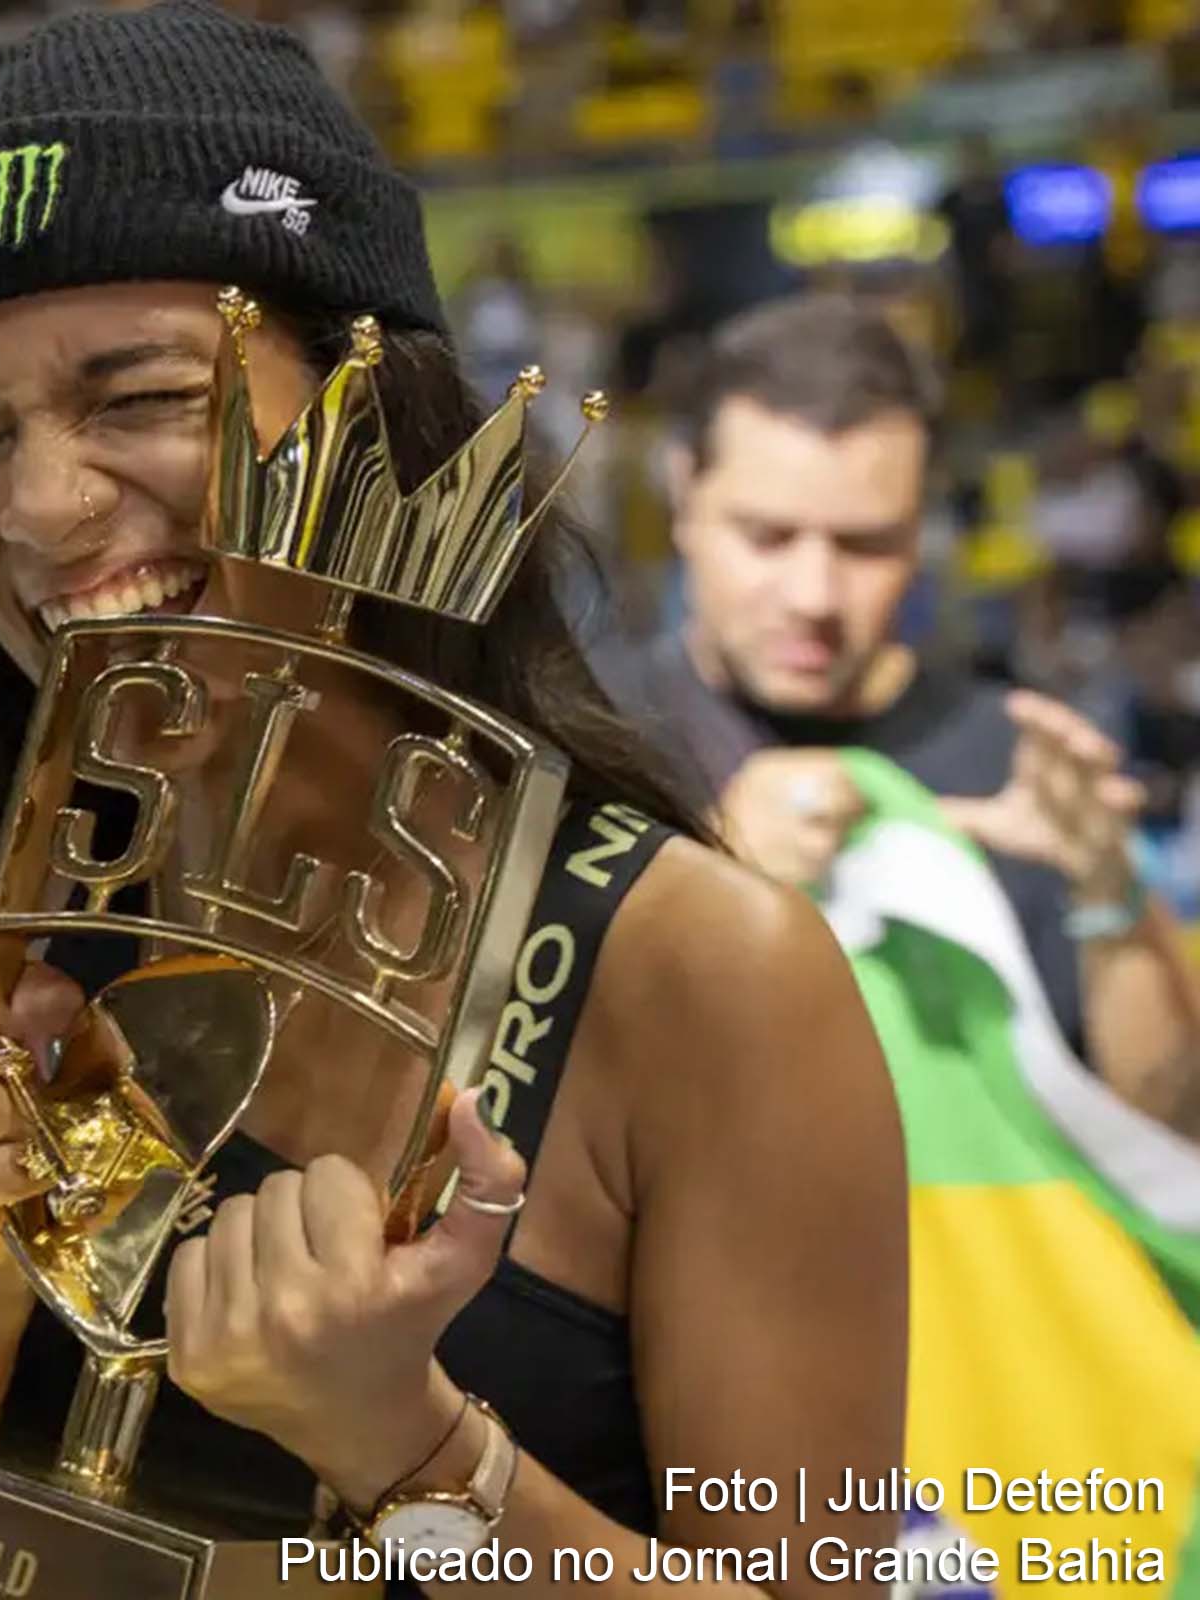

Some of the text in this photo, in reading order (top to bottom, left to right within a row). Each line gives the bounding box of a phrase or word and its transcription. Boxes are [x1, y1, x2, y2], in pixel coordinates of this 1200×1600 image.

[240, 165, 301, 201] NIKE
[282, 206, 311, 236] SB
[48, 661, 492, 982] SLS
[482, 804, 650, 1148] PRO NI
